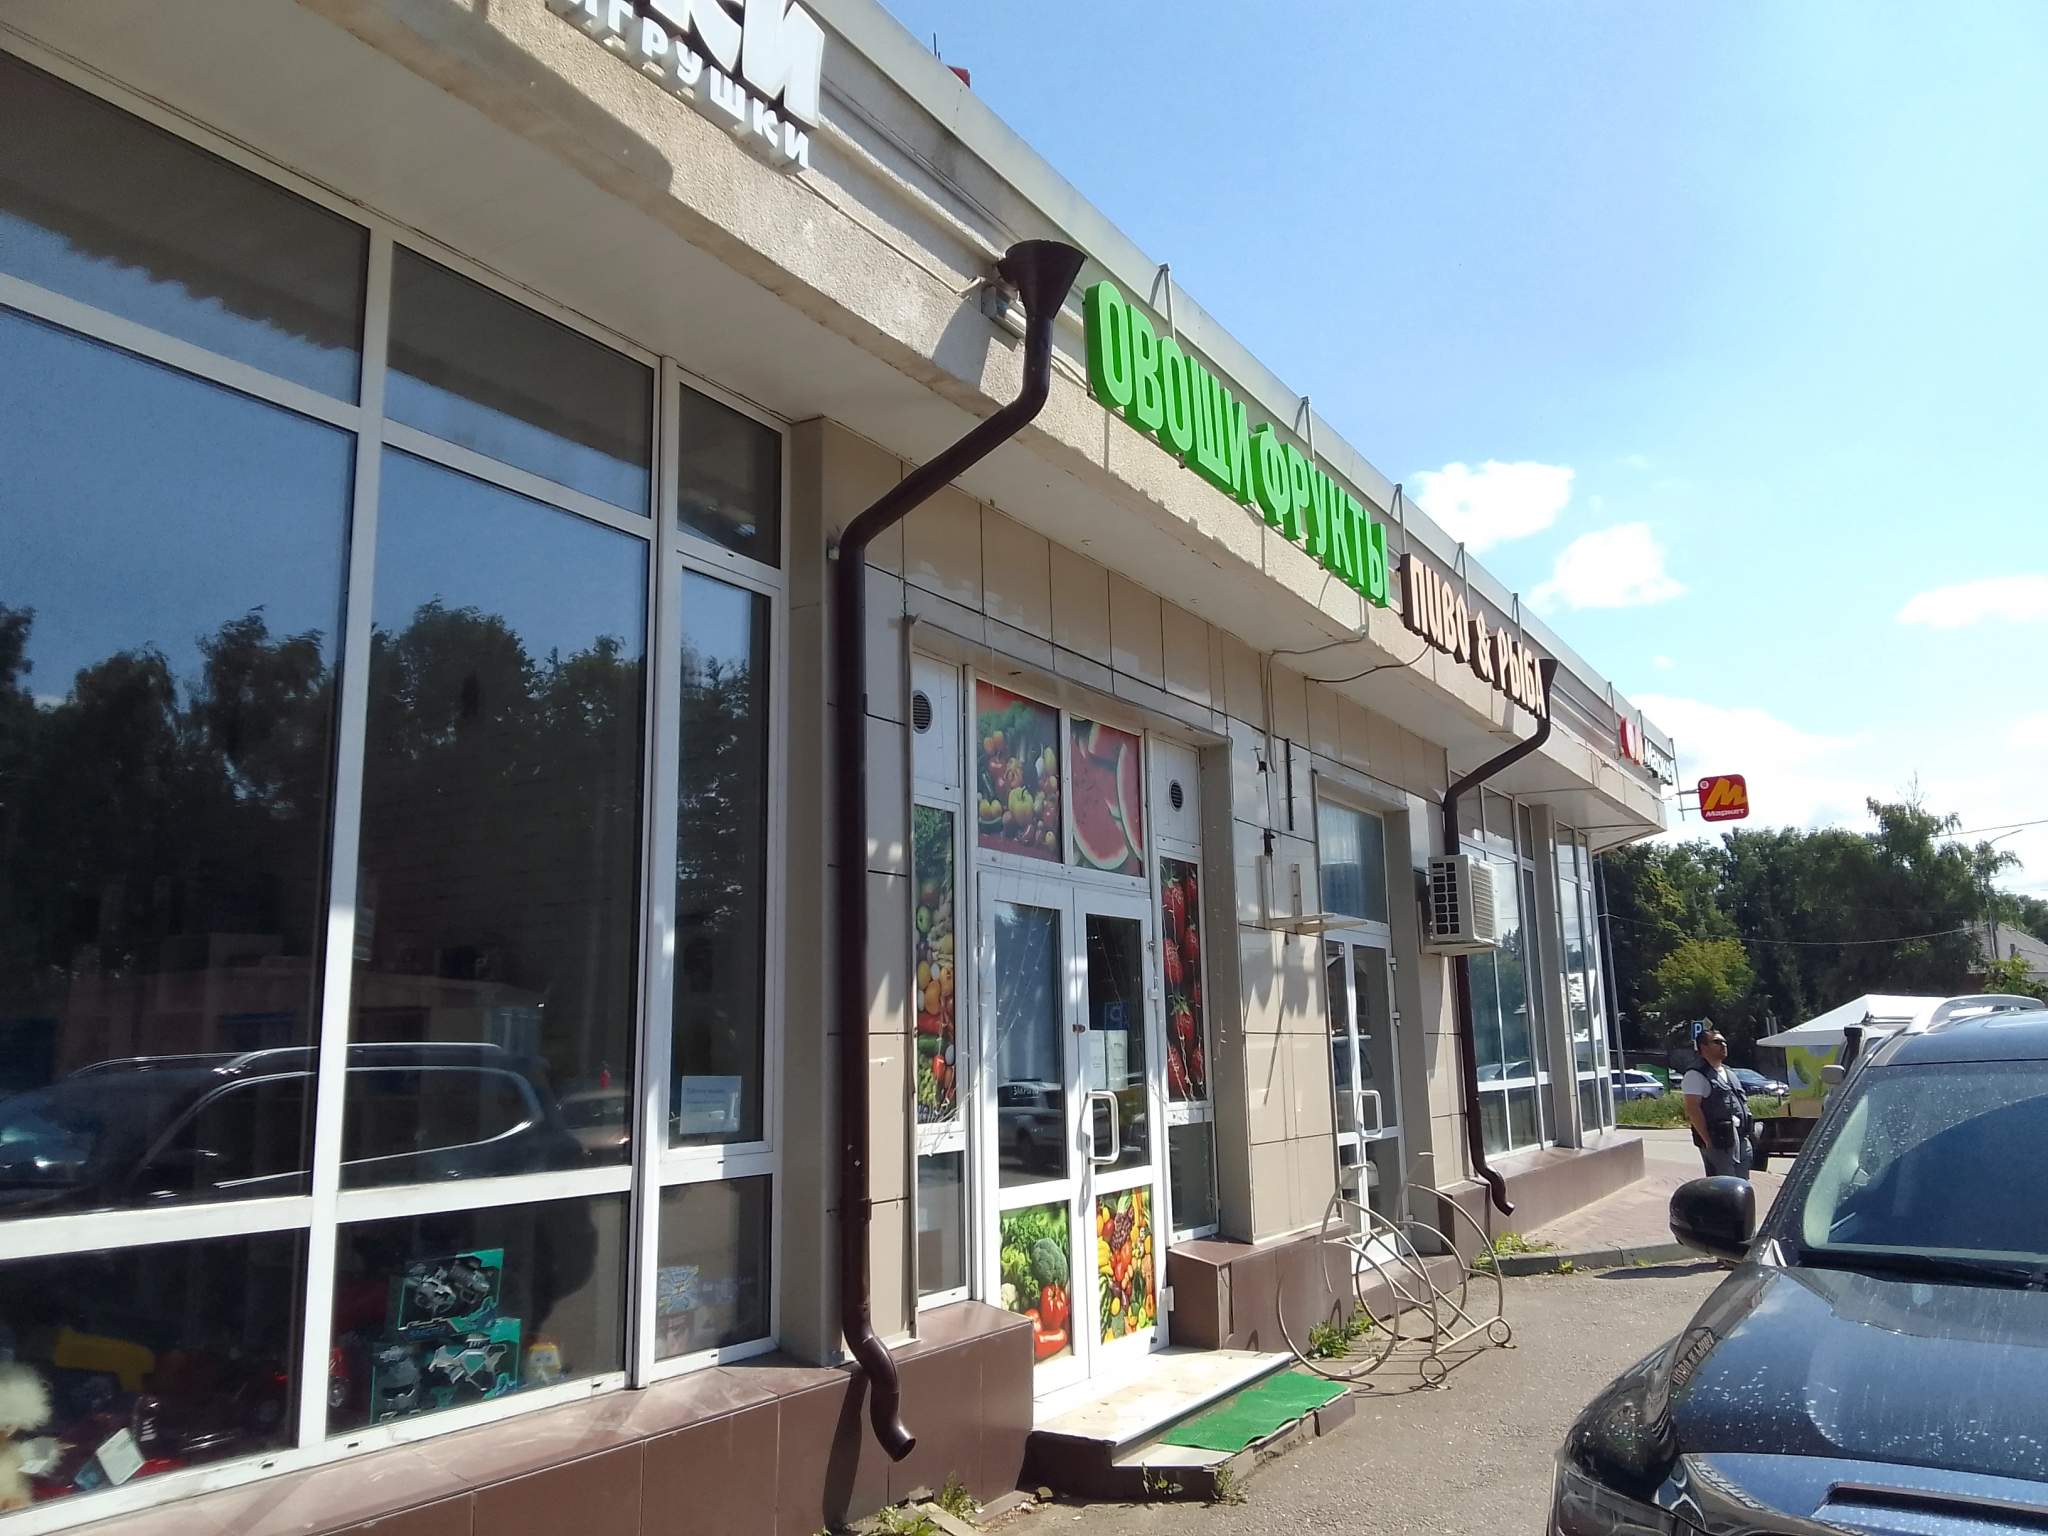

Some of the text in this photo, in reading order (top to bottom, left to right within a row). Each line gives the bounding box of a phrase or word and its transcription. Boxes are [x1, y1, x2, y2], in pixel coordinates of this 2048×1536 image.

[1086, 279, 1390, 609] ОВОЩИ ФРУКТЫ
[1403, 553, 1548, 720] ПИВО & РЫБА
[1694, 1022, 1703, 1039] P
